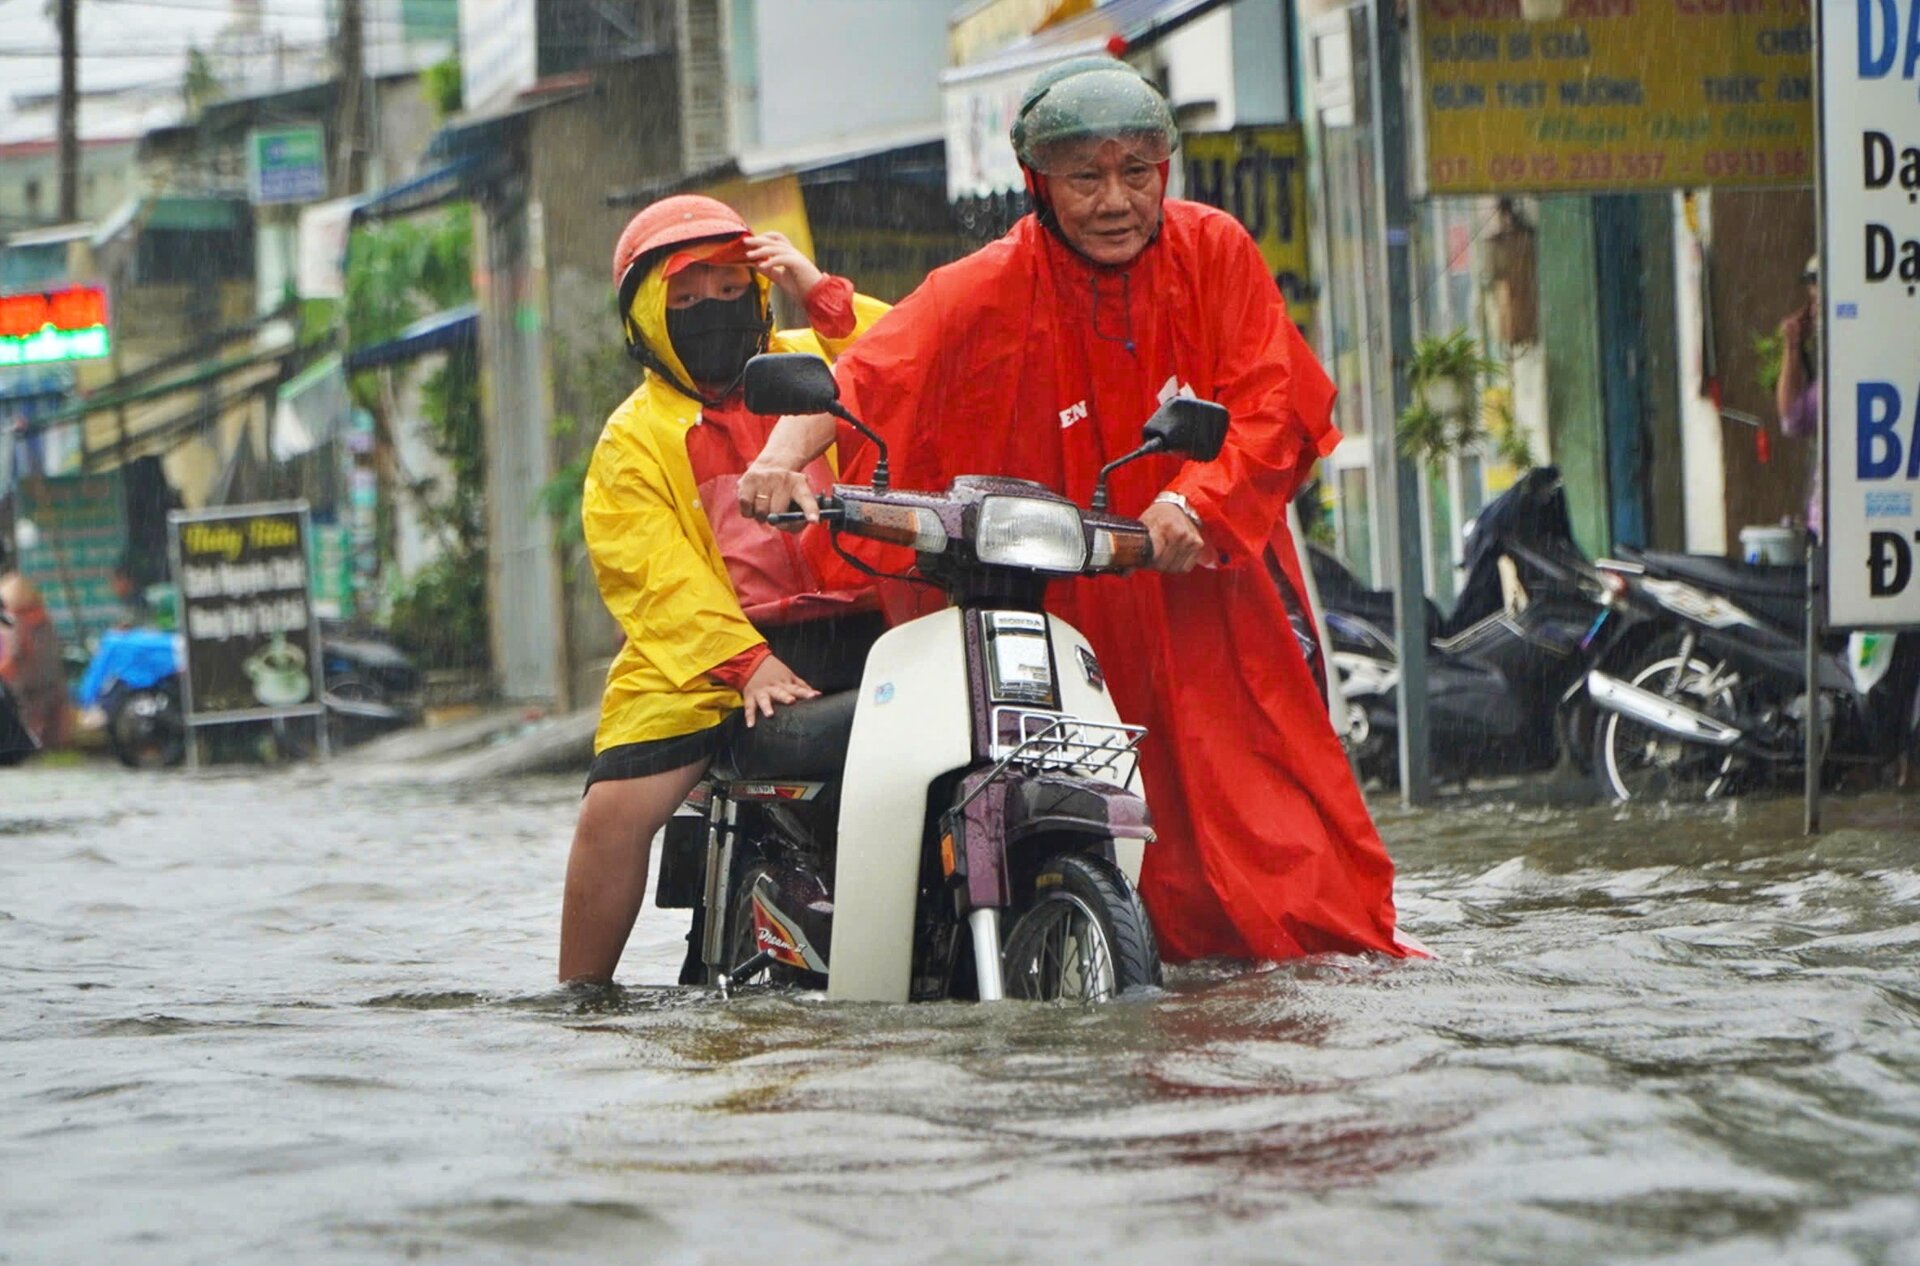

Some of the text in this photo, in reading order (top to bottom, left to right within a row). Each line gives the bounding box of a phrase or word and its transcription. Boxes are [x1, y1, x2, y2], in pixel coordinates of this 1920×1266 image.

[1867, 531, 1920, 597] Đ
[999, 617, 1041, 627] HONDA
[747, 785, 776, 795] HONDA
